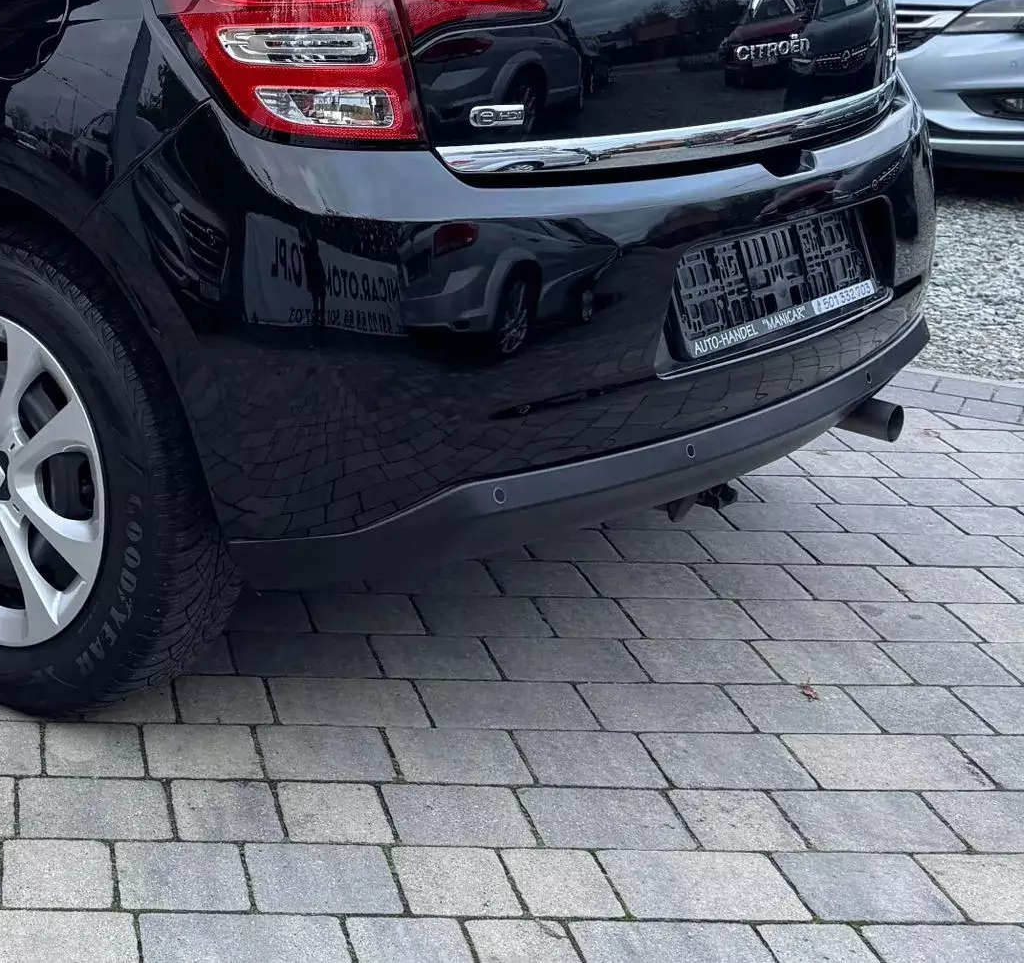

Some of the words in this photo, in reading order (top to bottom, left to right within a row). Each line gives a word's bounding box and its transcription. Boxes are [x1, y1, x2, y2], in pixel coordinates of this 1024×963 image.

[735, 33, 810, 62] CITROËN
[694, 324, 759, 355] AUTO-HANDEL
[762, 305, 806, 331] "MANICAR"
[75, 492, 144, 676] GOODYEAR
